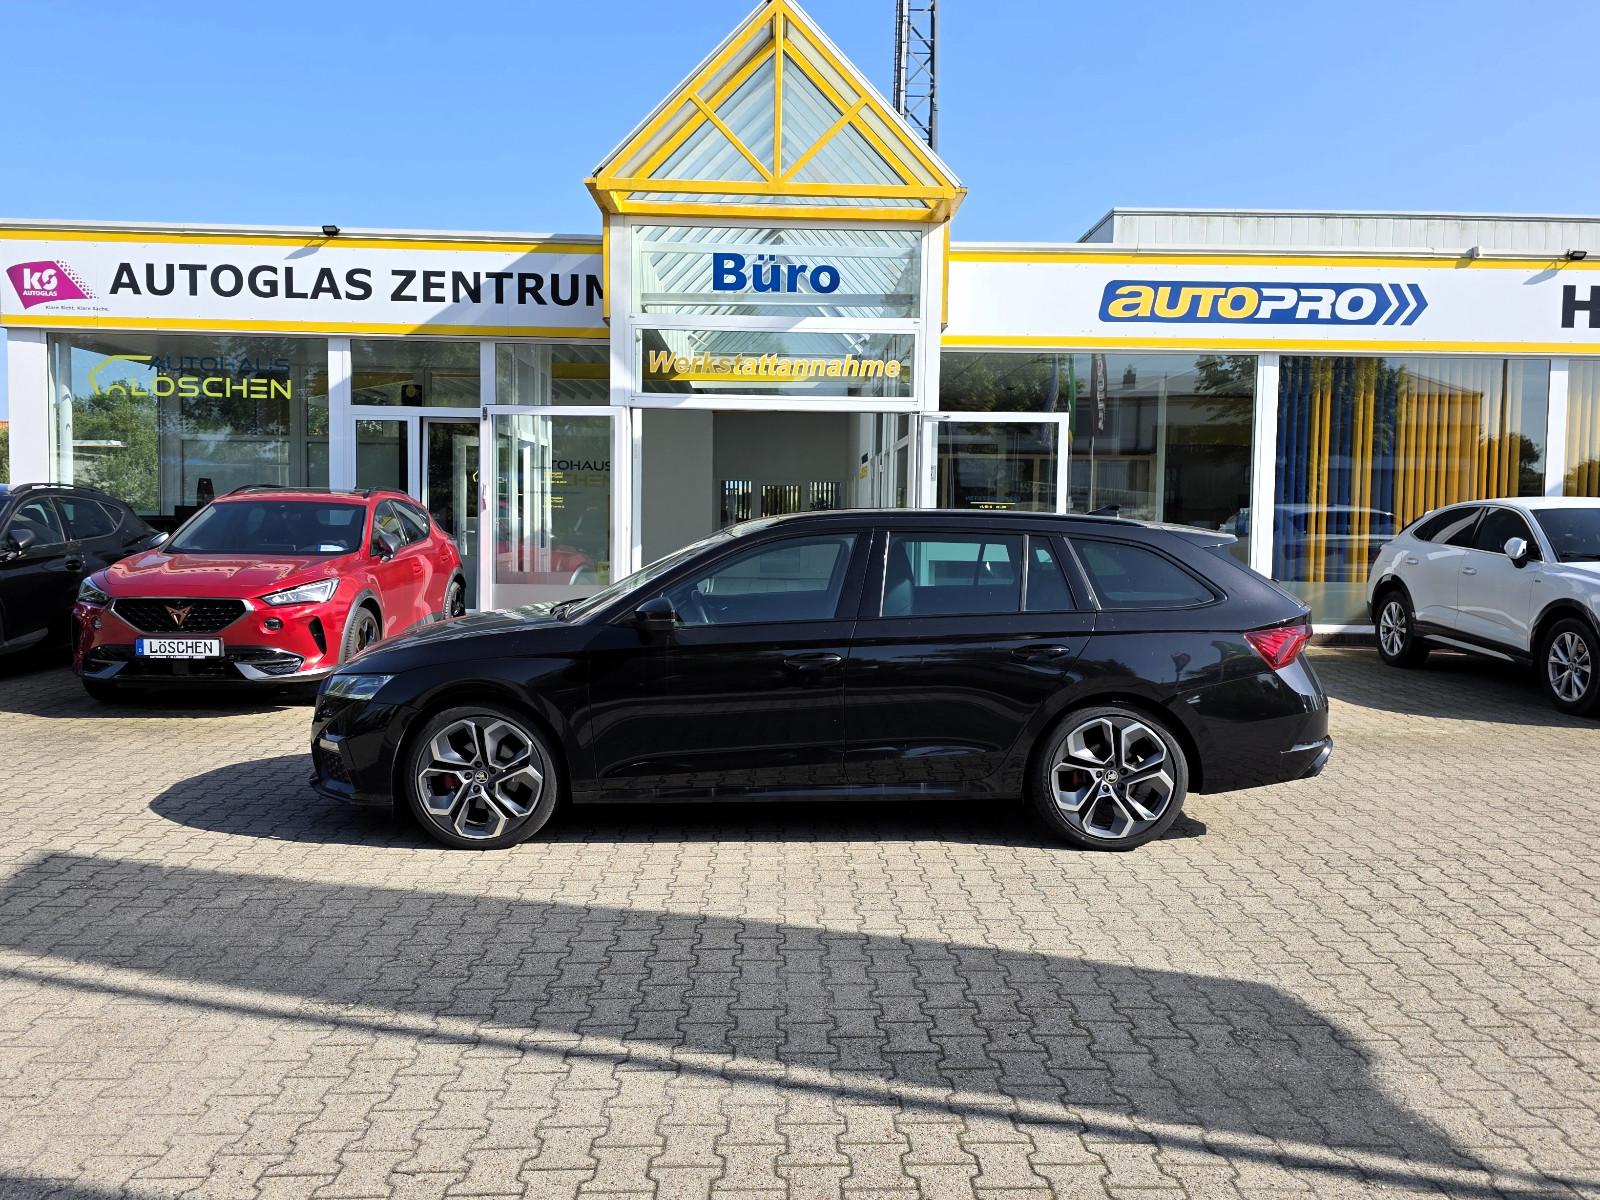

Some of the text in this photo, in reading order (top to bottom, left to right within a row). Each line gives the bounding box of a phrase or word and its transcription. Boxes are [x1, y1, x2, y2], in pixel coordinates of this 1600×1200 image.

[109, 262, 372, 300] AUTOGLAS
[712, 252, 840, 293] Büro
[148, 354, 290, 373] AUTOHAUS
[648, 350, 901, 378] Werkstattannahme
[131, 372, 292, 399] LÖSCHEN
